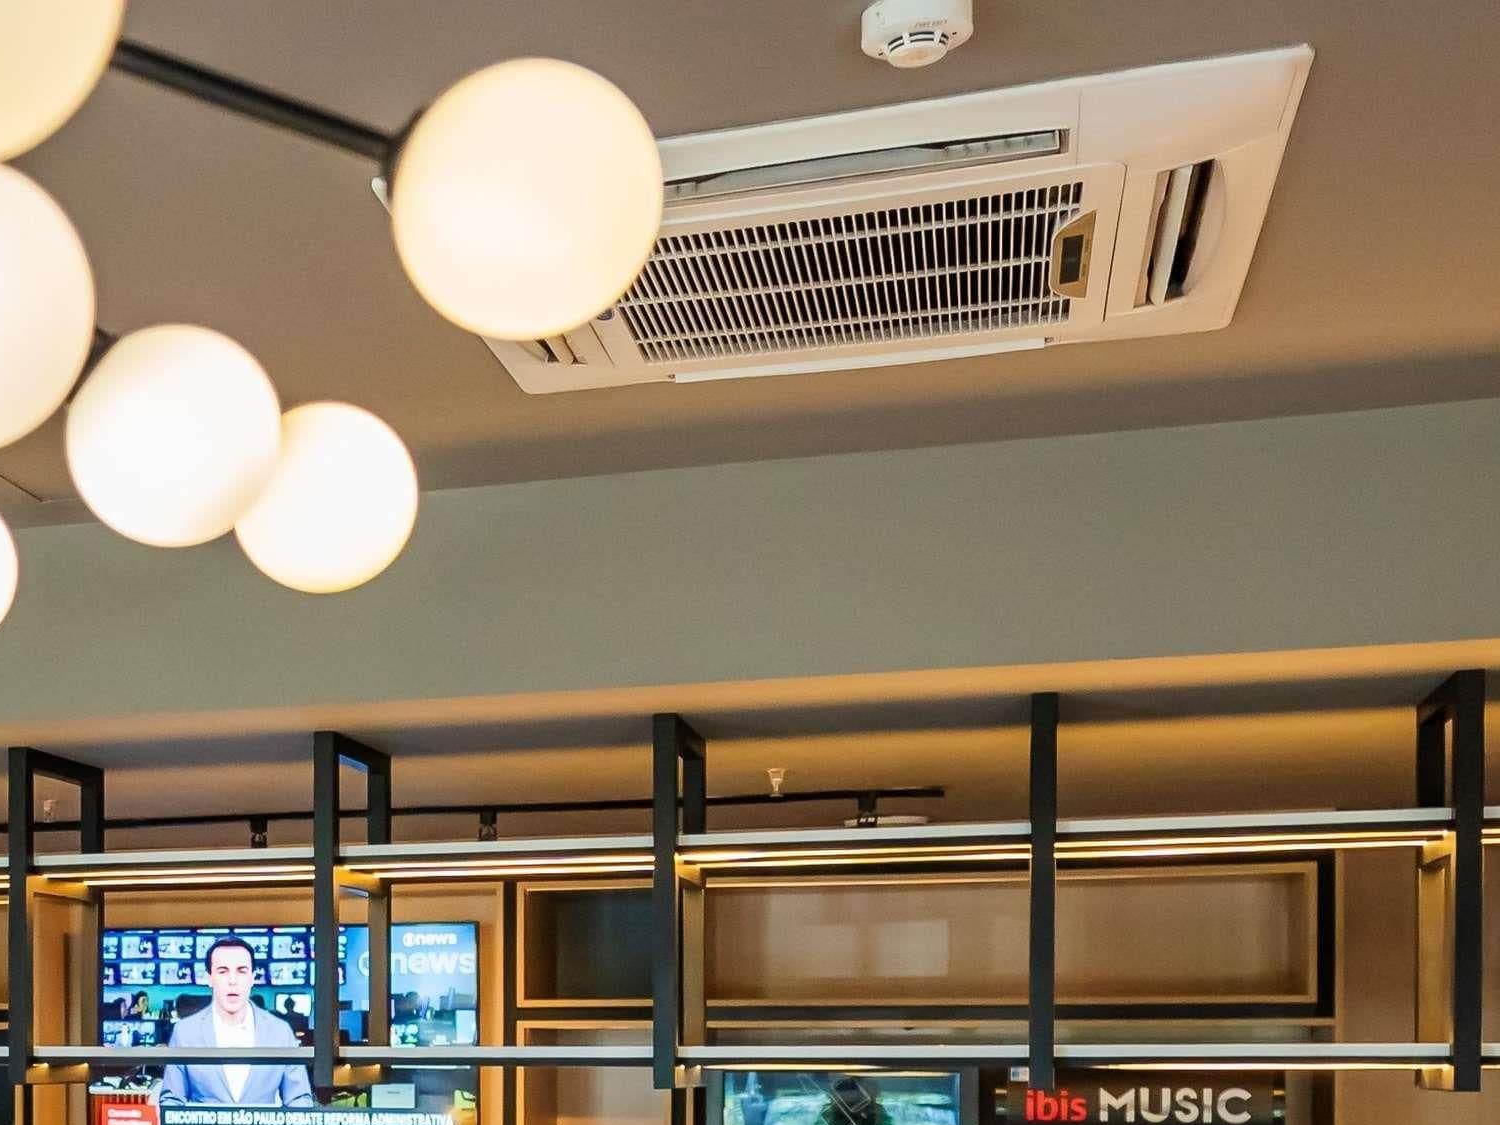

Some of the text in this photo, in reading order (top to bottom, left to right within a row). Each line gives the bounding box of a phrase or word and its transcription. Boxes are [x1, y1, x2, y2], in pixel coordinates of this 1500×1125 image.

[165, 1110, 217, 1125] ENCONTRO
[217, 1111, 232, 1125] EM
[232, 1108, 253, 1125] SÃO
[253, 1111, 285, 1125] PAULO
[285, 1111, 323, 1125] DEBATE
[1024, 1087, 1252, 1124] ibis MUSIC
